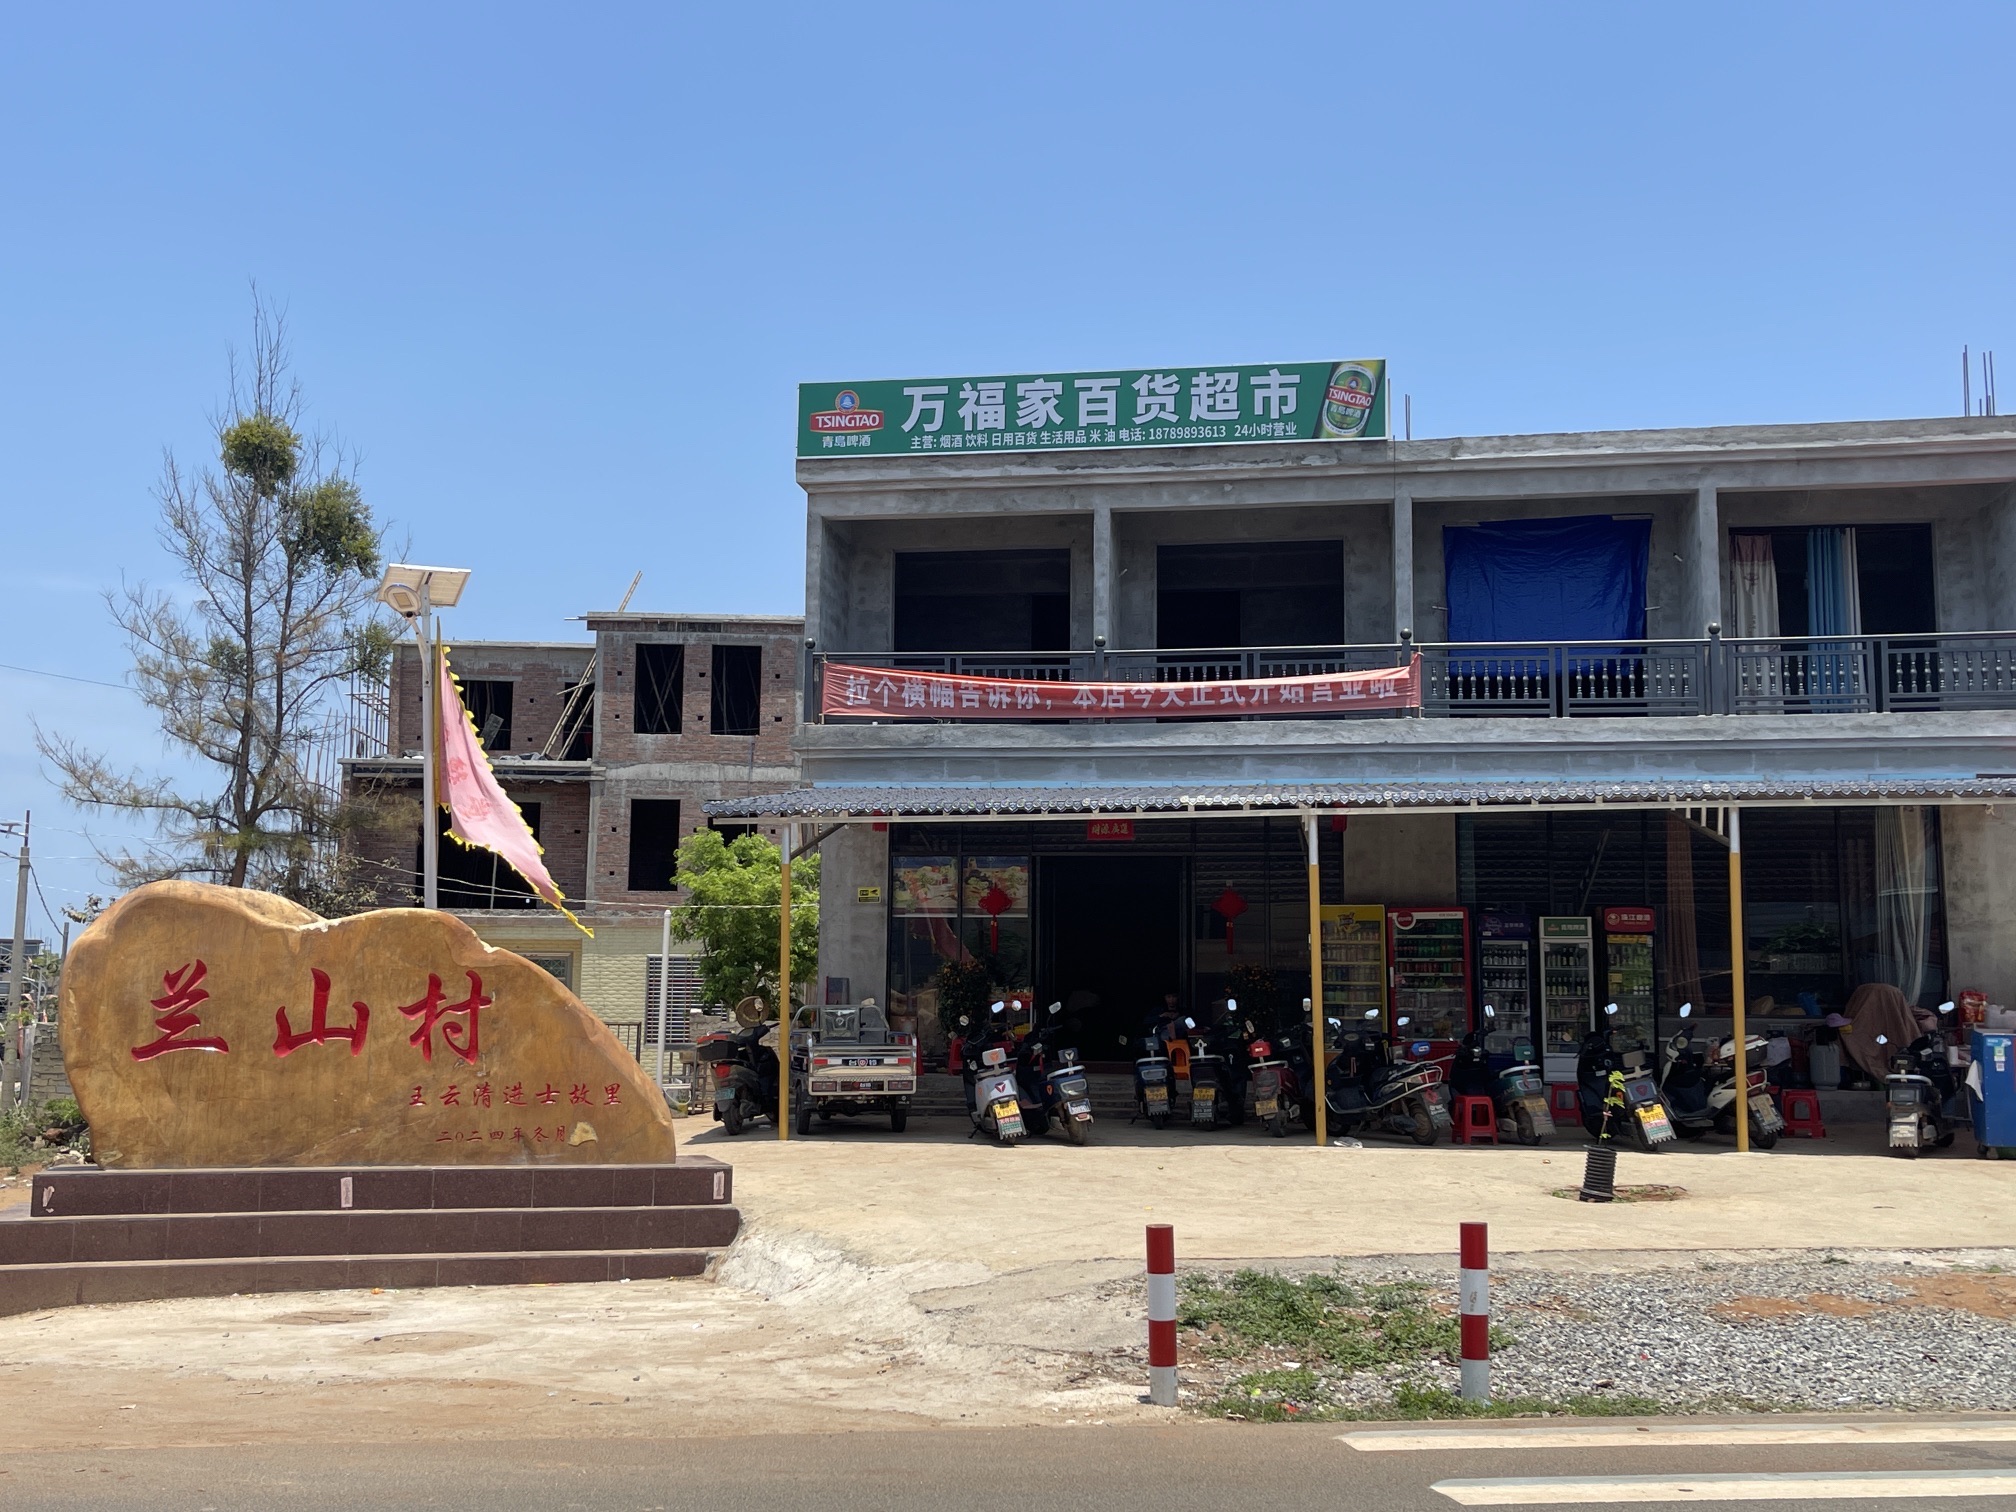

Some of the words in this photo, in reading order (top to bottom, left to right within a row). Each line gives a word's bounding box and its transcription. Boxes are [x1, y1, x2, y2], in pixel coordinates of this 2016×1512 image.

[901, 370, 1301, 433] 万福家百货超市
[1328, 388, 1372, 407] TSINGTAO
[815, 413, 880, 428] TSINGTAO
[939, 434, 963, 448] 烟酒
[965, 433, 989, 448] 饮料
[992, 431, 1037, 447] 日用百货
[1040, 430, 1087, 445] 生活用品
[1089, 429, 1101, 443] 米
[1104, 428, 1116, 442] 油
[1149, 425, 1226, 440] 18789893613
[1234, 422, 1298, 438] 24小时营业
[131, 959, 492, 1065] 兰山村
[409, 1081, 622, 1108] 王云清进士故里
